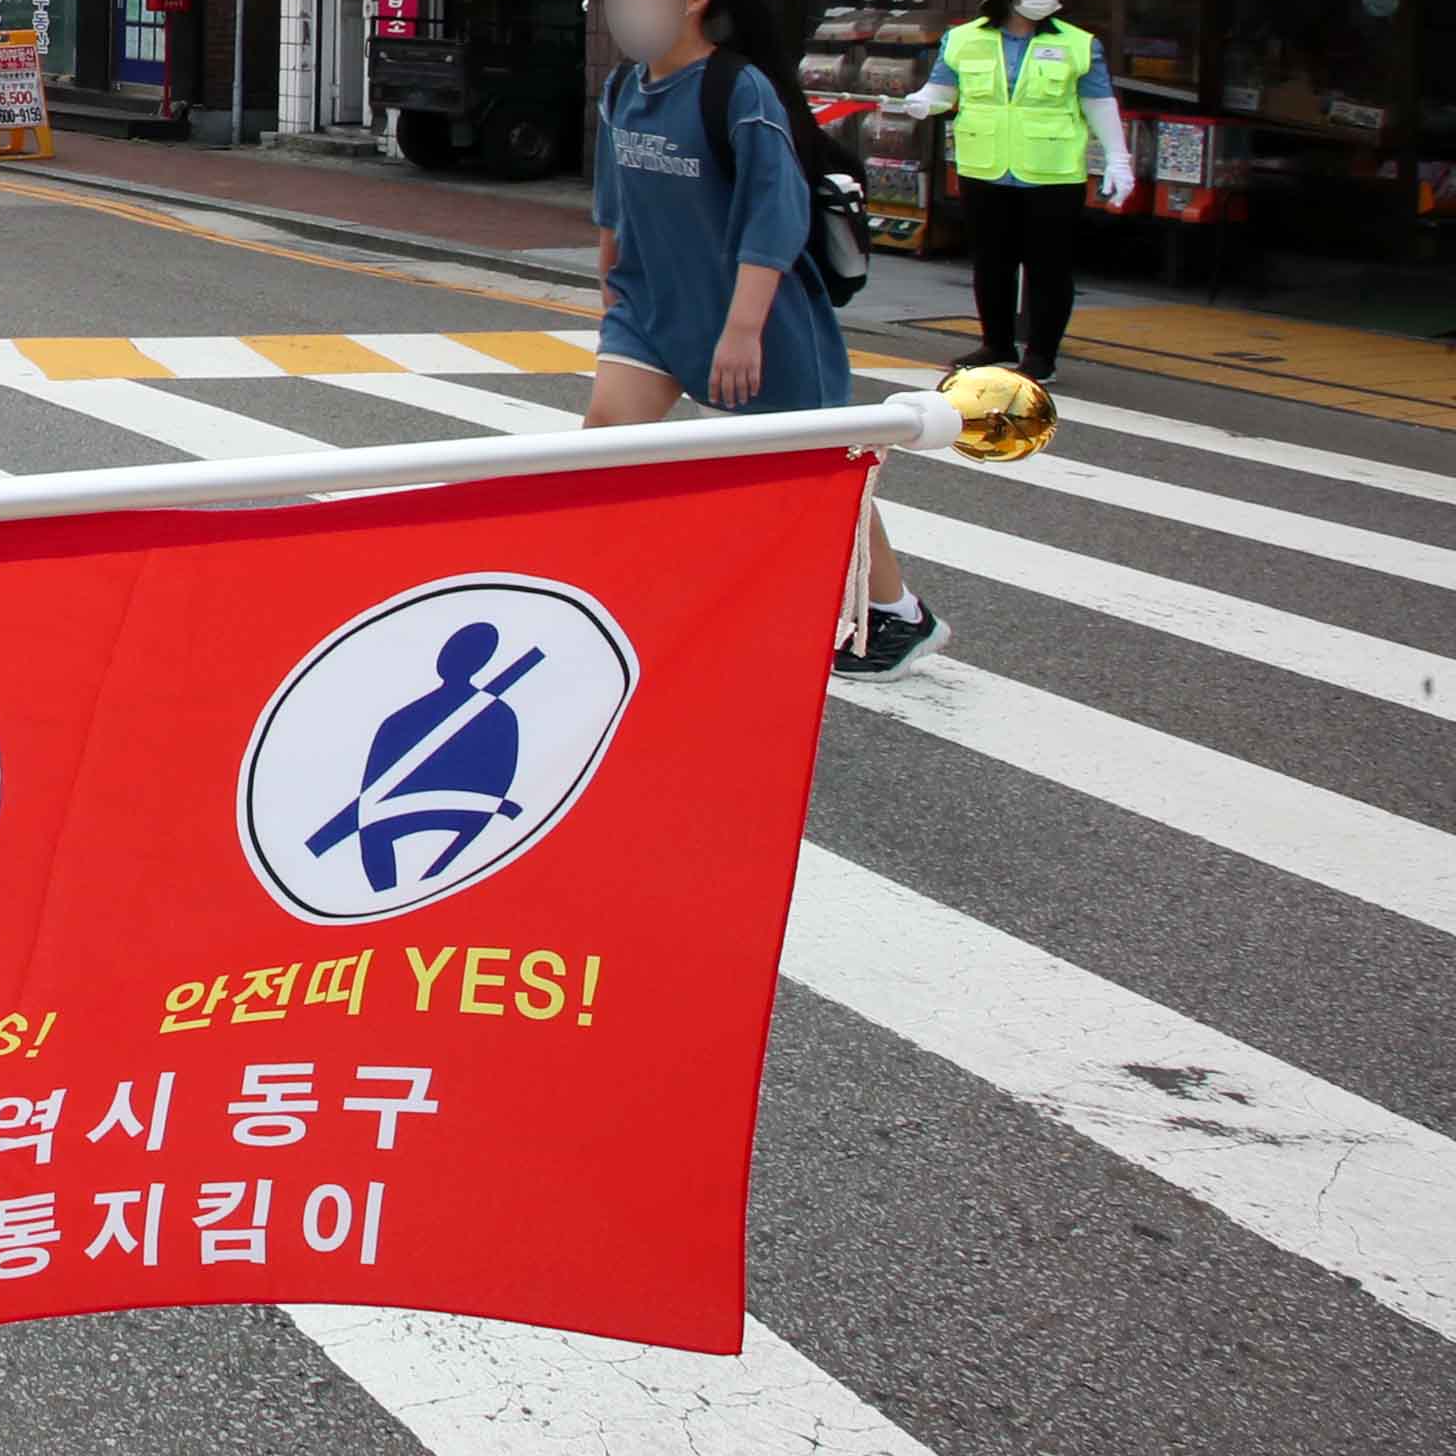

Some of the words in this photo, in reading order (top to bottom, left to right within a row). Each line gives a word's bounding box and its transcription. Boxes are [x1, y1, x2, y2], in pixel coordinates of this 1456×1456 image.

[159, 948, 376, 1034] 안전띠
[404, 946, 602, 1026] YES!
[226, 1062, 440, 1151] 동구
